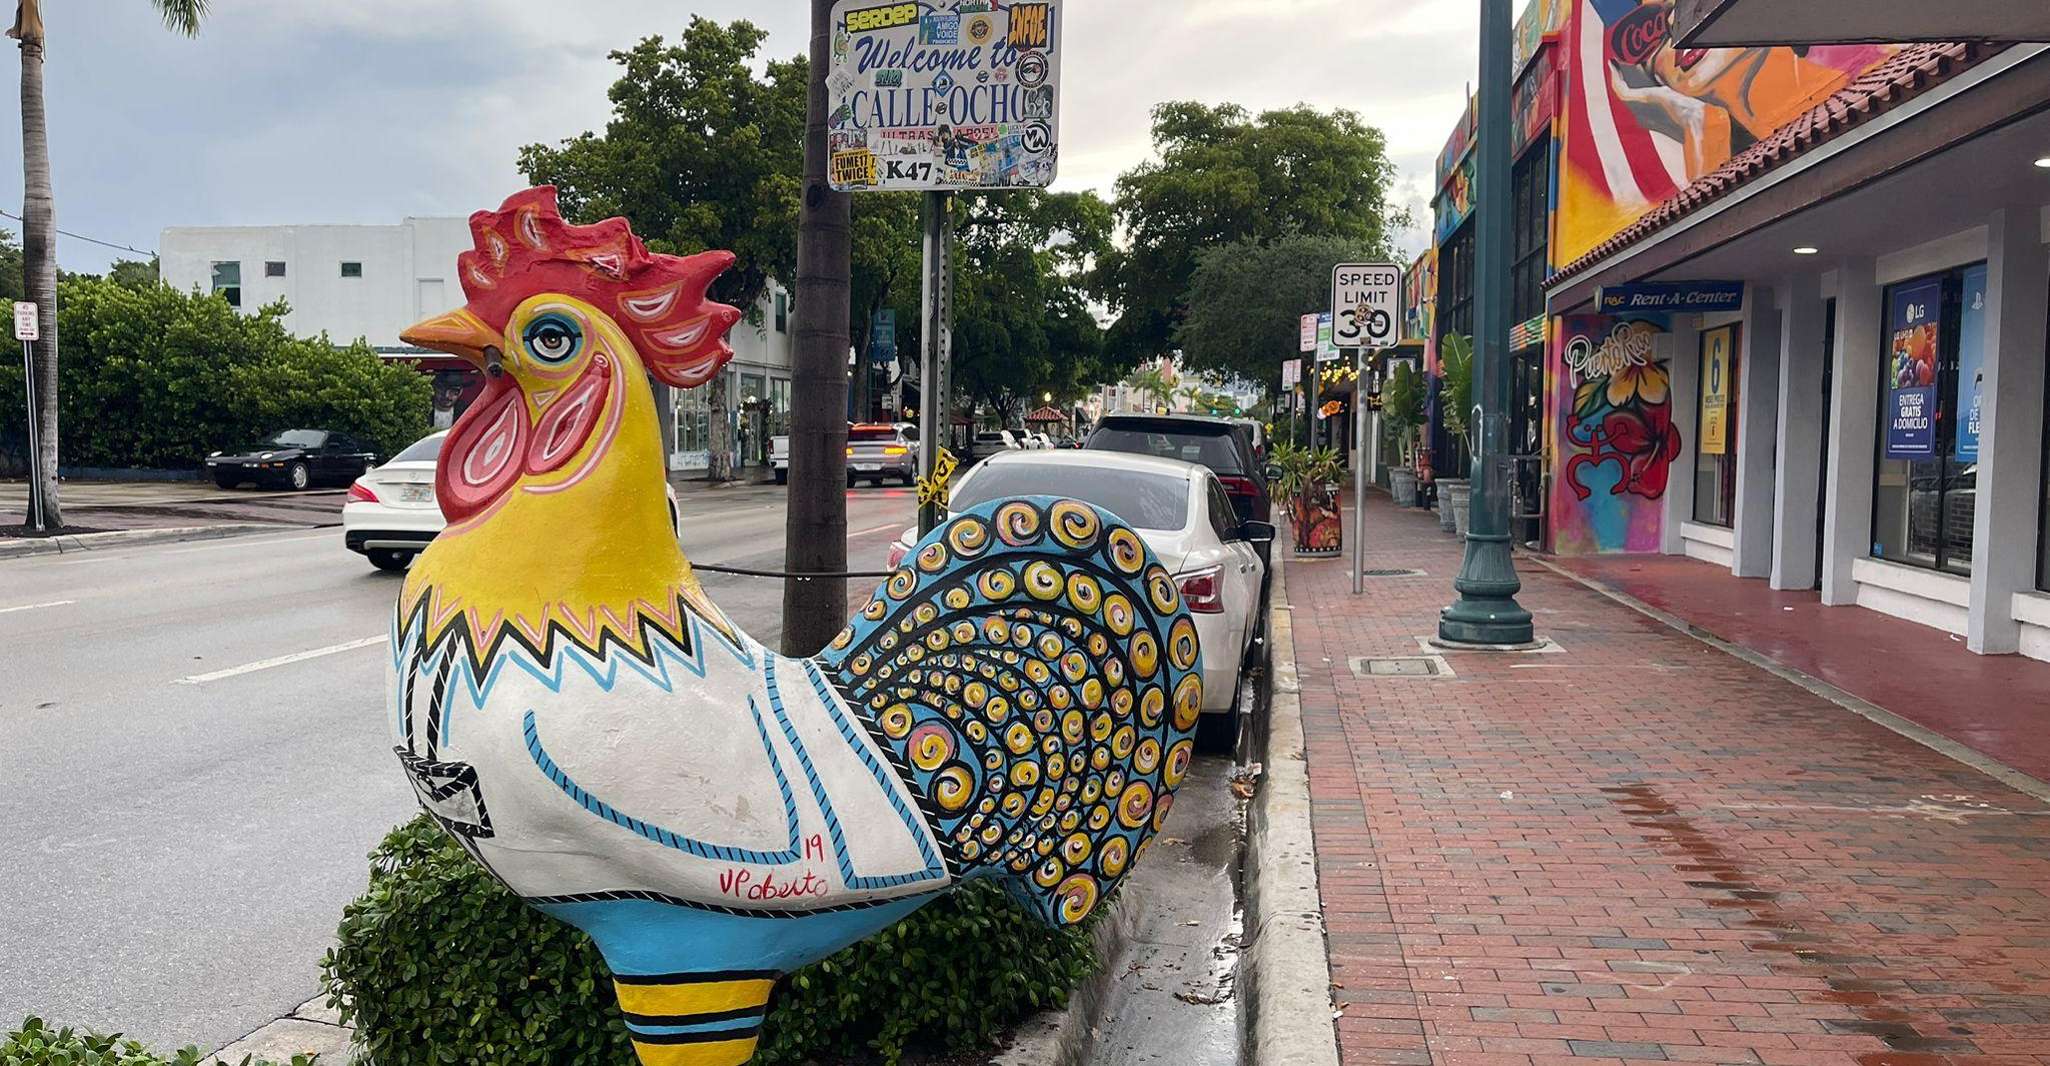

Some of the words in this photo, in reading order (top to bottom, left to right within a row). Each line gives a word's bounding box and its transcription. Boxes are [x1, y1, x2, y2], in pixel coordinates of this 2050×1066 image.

[855, 35, 982, 74] Welcome
[990, 36, 1017, 69] to
[851, 88, 938, 128] CALLE
[836, 167, 869, 182] TWICE
[886, 160, 932, 181] K47
[1339, 273, 1395, 286] SPEED
[1344, 291, 1388, 303] LIMIT
[1914, 304, 1925, 319] LG
[1338, 309, 1391, 338] 30
[1711, 336, 1721, 394] 6
[1898, 393, 1925, 406] ENTREGA
[1900, 406, 1921, 418] GRATIS
[1892, 418, 1898, 430] A
[1898, 416, 1928, 430] DOMICILIO
[804, 833, 824, 862] 19
